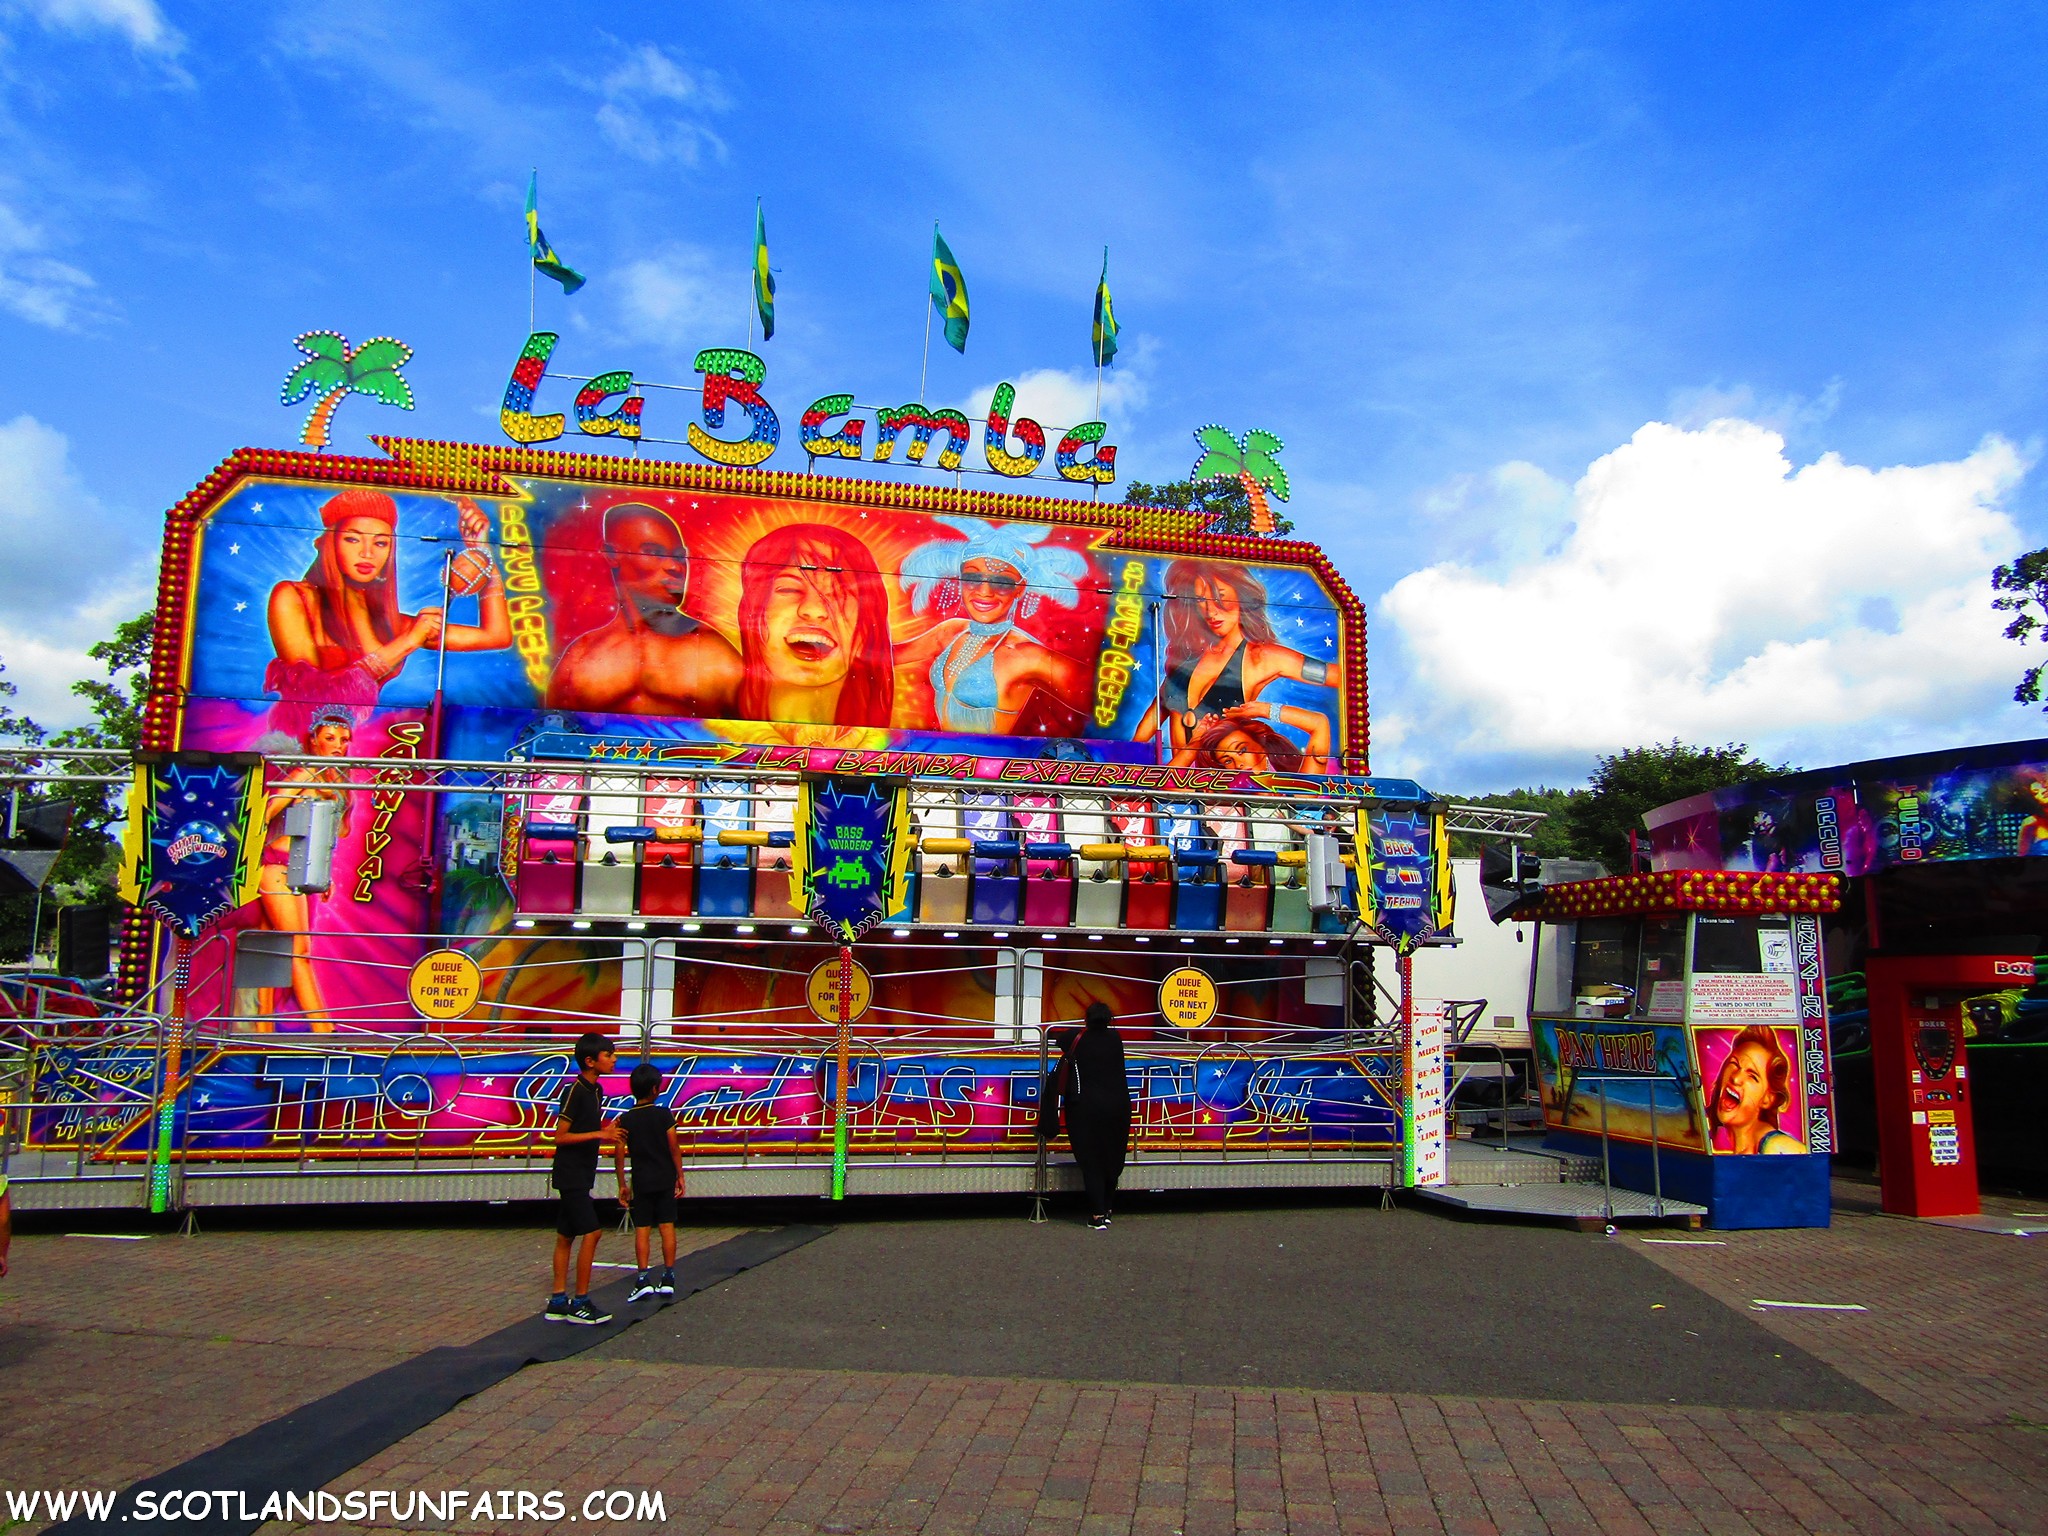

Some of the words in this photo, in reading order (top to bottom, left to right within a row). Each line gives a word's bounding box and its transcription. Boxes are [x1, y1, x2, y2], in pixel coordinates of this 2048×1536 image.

[501, 332, 645, 444] La
[687, 348, 1118, 484] Bamba
[757, 747, 811, 768] LA
[835, 751, 977, 779] BAMBA
[1001, 759, 1237, 791] EXPERIENCE
[354, 722, 424, 901] CARNIVAL
[1897, 785, 1922, 860] TECHNO
[836, 826, 864, 839] BASS
[1815, 797, 1841, 868] DANCE
[828, 839, 873, 851] INVADERS
[1384, 840, 1420, 856] BACK
[172, 844, 193, 865] THIS
[193, 843, 227, 858] WORLD
[1385, 896, 1422, 909] TECHNO
[431, 962, 462, 972] QUEUE
[433, 975, 457, 984] HERE
[1176, 978, 1201, 987] QUEUE
[420, 987, 439, 995] FOR
[444, 987, 469, 996] NEXT
[818, 992, 834, 1000] FOR
[1178, 989, 1198, 998] HERE
[433, 999, 455, 1008] RIDE
[1169, 1000, 1184, 1008] FOR
[1188, 1001, 1207, 1010] NEXT
[1179, 1011, 1197, 1019] RIDE
[1420, 1025, 1438, 1036] YOU
[1418, 1045, 1440, 1058] MUST
[1554, 1027, 1597, 1068] PAY
[1597, 1031, 1656, 1073] HERE
[1418, 1070, 1427, 1079] BE
[1430, 1065, 1441, 1075] AS
[263, 1056, 432, 1140] The
[820, 1060, 976, 1137] HAS
[1419, 1087, 1440, 1099] TALL
[1415, 1113, 1426, 1122] AS
[1428, 1106, 1442, 1117] THE
[1421, 1129, 1438, 1141] LINE
[1424, 1152, 1436, 1160] TO
[1420, 1171, 1440, 1183] RIDE
